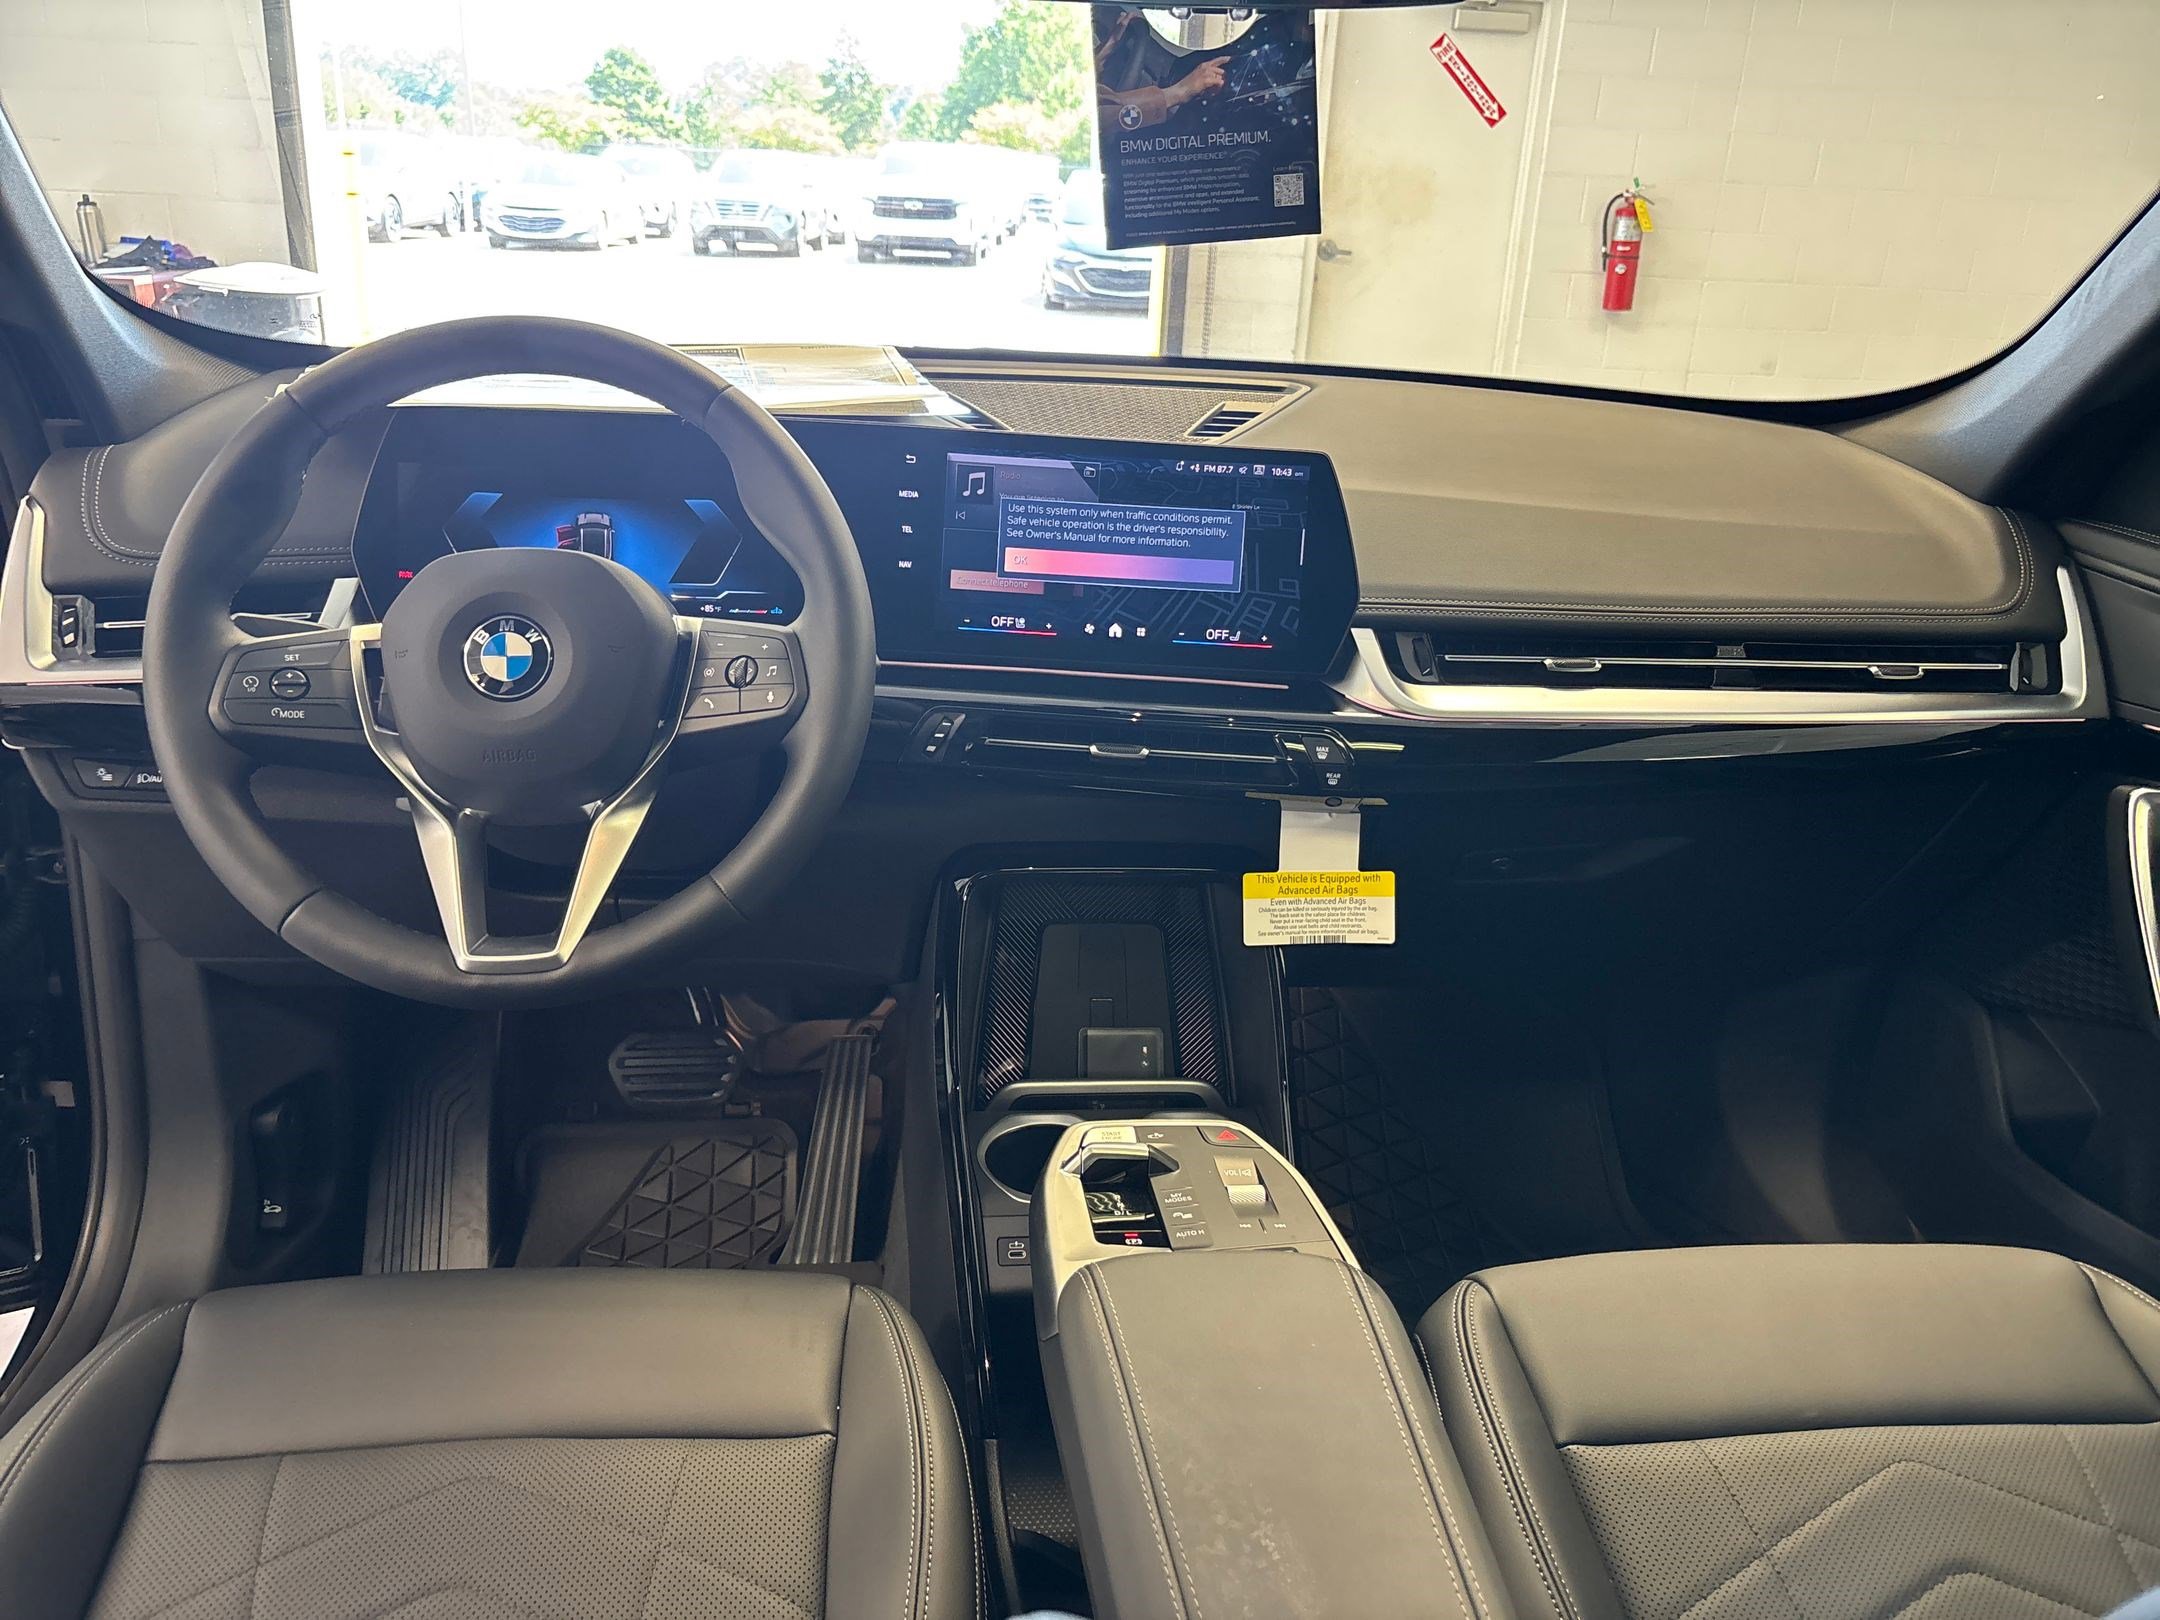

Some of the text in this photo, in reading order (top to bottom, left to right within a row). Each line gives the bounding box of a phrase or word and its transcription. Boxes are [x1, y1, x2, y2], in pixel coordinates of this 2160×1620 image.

[1437, 42, 1454, 61] FIRE
[1120, 130, 1272, 153] BMW DIGITAL PREMIUM.
[1121, 157, 1157, 167] ENHANCE
[1158, 155, 1178, 164] YOUR
[1203, 464, 1233, 474] FM 87.7
[1271, 467, 1292, 477] 10:43
[899, 490, 919, 498] MEDIA
[1008, 503, 1233, 525] Use this system only when traffic conditions permit.
[901, 525, 913, 534] TEL
[1007, 515, 1229, 539] Safe vehicle operation is the driver's responsibility.
[1006, 527, 1191, 548] See Owner's Manual for more information.
[898, 560, 912, 568] NAV
[1013, 555, 1029, 565] OK
[991, 578, 1029, 590] telephone
[991, 615, 1015, 627] OFF
[473, 619, 543, 646] BMW
[1205, 629, 1230, 640] OFF
[284, 653, 300, 662] SET
[279, 710, 305, 719] MODE
[482, 749, 537, 765] AIRBAG
[1256, 873, 1381, 885] This Vehicle is Equipped with
[1278, 885, 1359, 896] Advanced Air Bags
[1270, 897, 1367, 906] Even with Advanced Air Bags
[1223, 1169, 1238, 1177] VOL
[1164, 1195, 1192, 1203] MODES
[1176, 1230, 1198, 1238] AUTO
